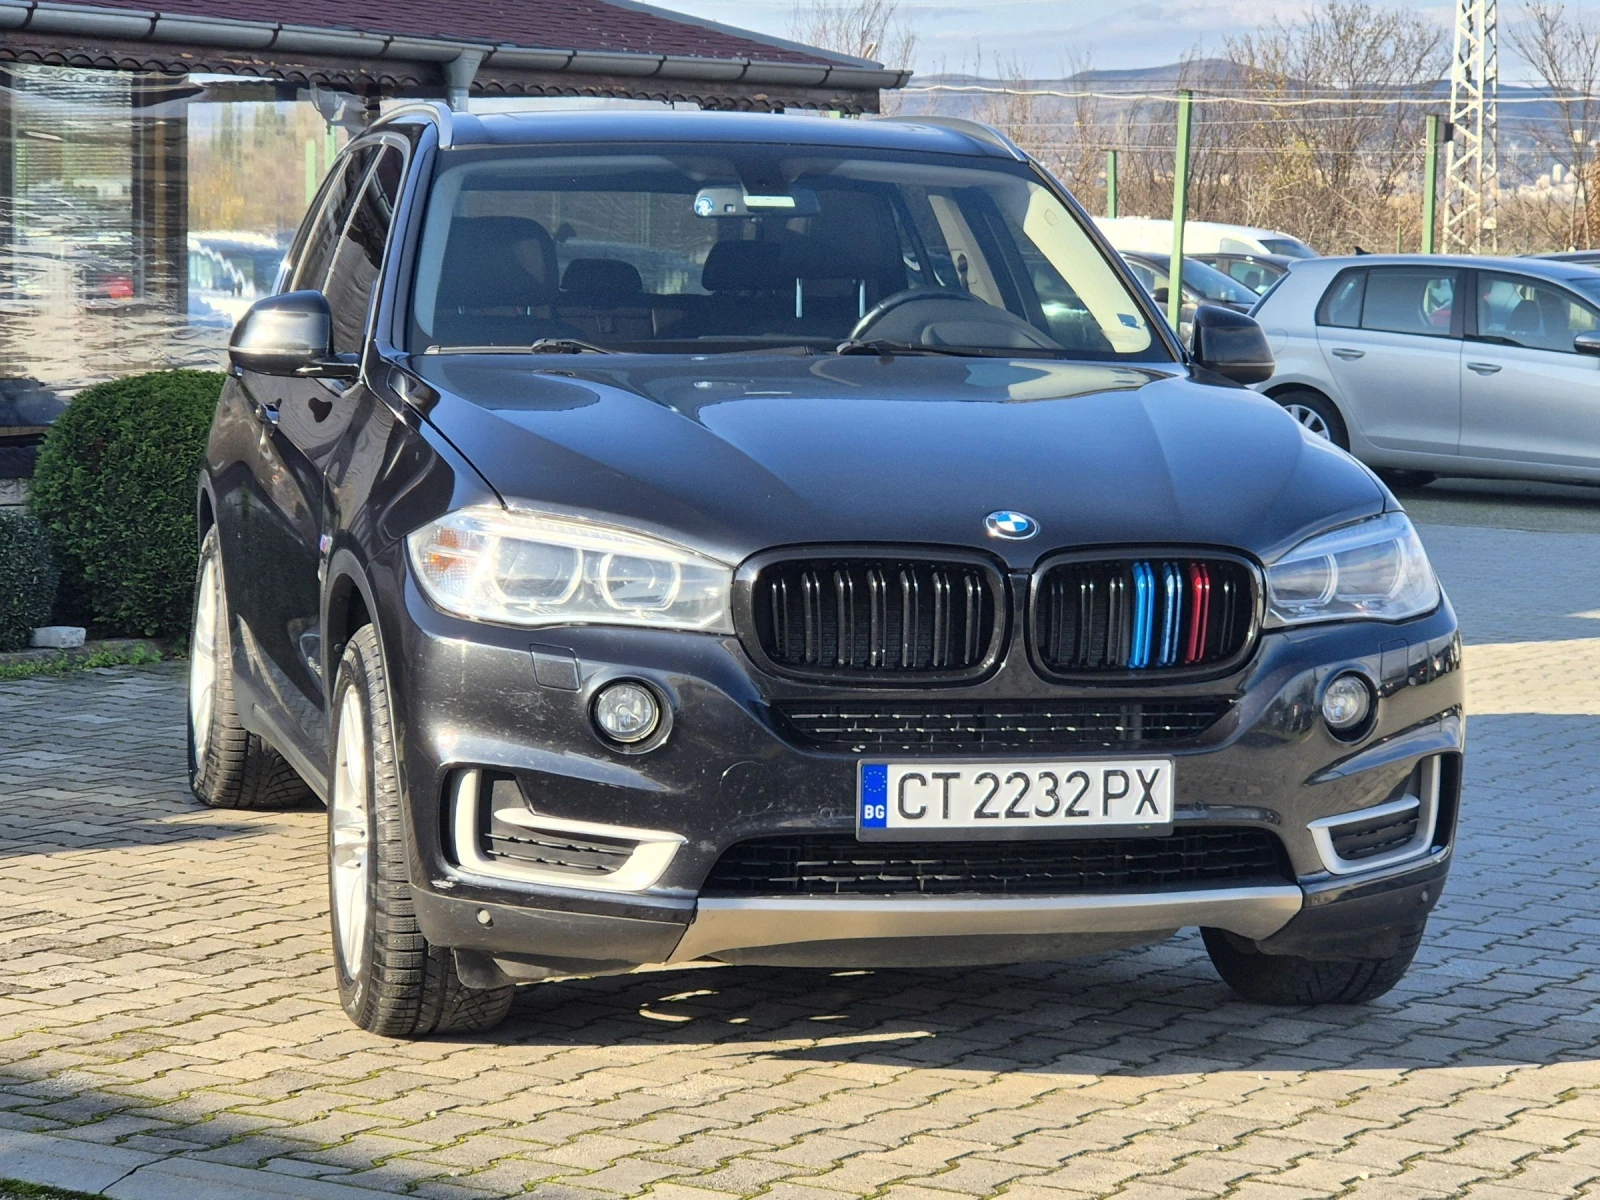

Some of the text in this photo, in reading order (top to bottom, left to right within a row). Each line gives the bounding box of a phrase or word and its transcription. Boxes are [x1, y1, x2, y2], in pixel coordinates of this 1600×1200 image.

[897, 768, 1161, 820] CT 2232 PX
[864, 804, 885, 819] BG
